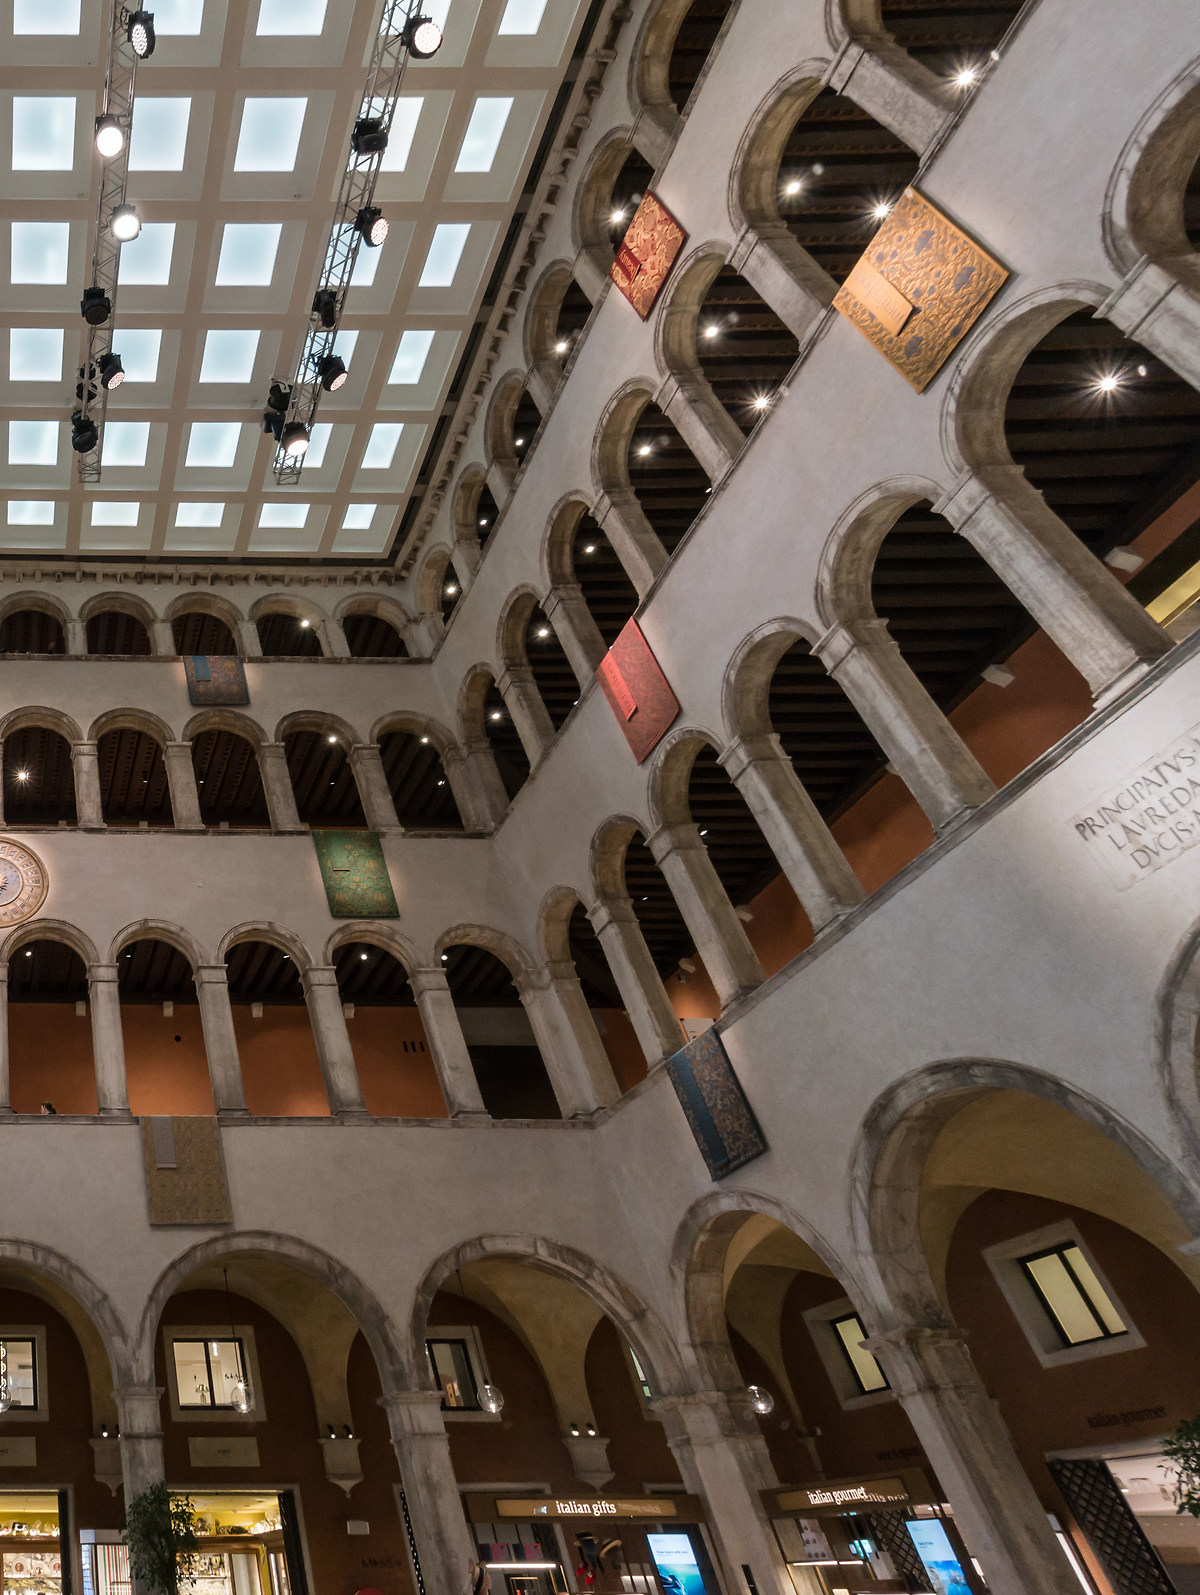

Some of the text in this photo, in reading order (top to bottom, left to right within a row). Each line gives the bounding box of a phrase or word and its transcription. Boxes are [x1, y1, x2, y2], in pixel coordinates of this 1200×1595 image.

[807, 1490, 834, 1505] italian
[833, 1486, 868, 1505] gourmet
[555, 1501, 592, 1514] italian
[591, 1501, 617, 1516] gifts
